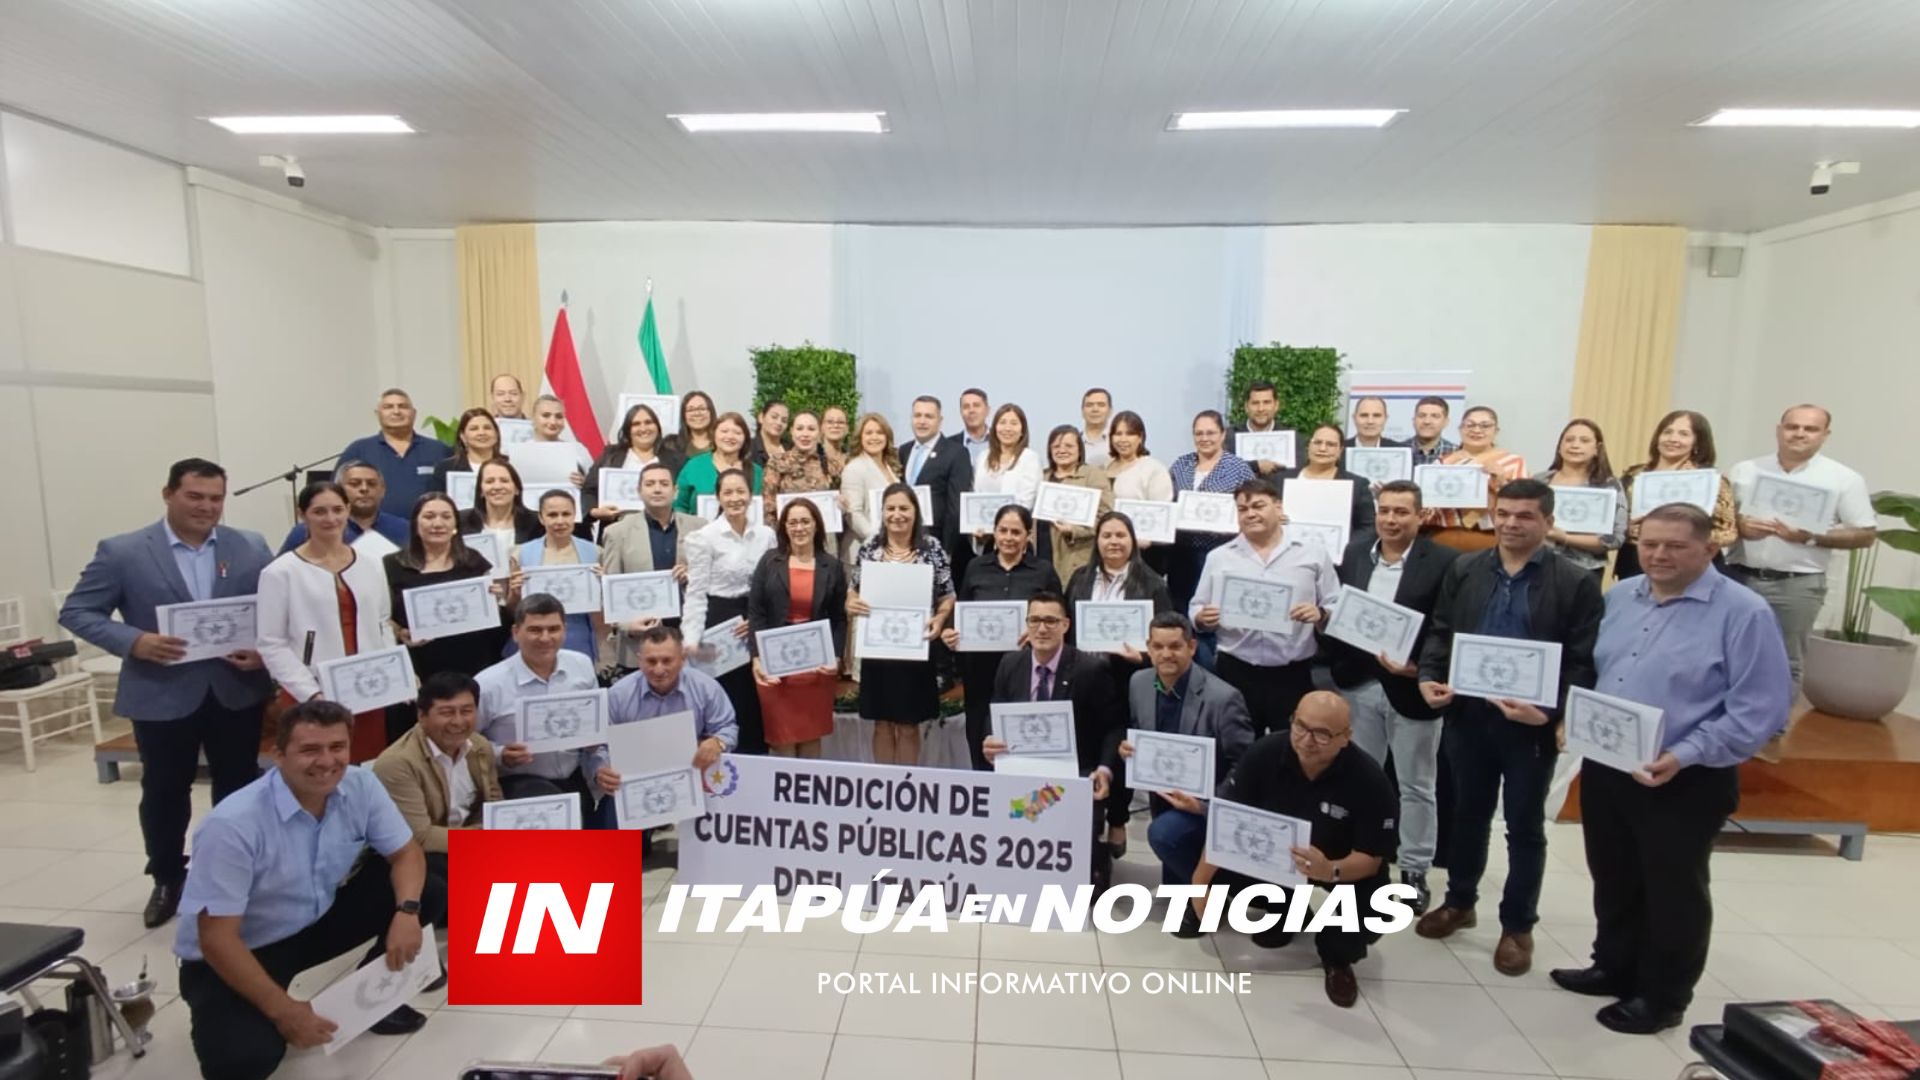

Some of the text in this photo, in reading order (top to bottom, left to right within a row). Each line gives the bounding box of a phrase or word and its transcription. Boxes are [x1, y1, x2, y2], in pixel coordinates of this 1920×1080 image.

[773, 771, 990, 817] RENDICIÓN DE
[694, 812, 1073, 872] CUENTAS PÚBLICAS 2025
[871, 872, 983, 915] IAÚA
